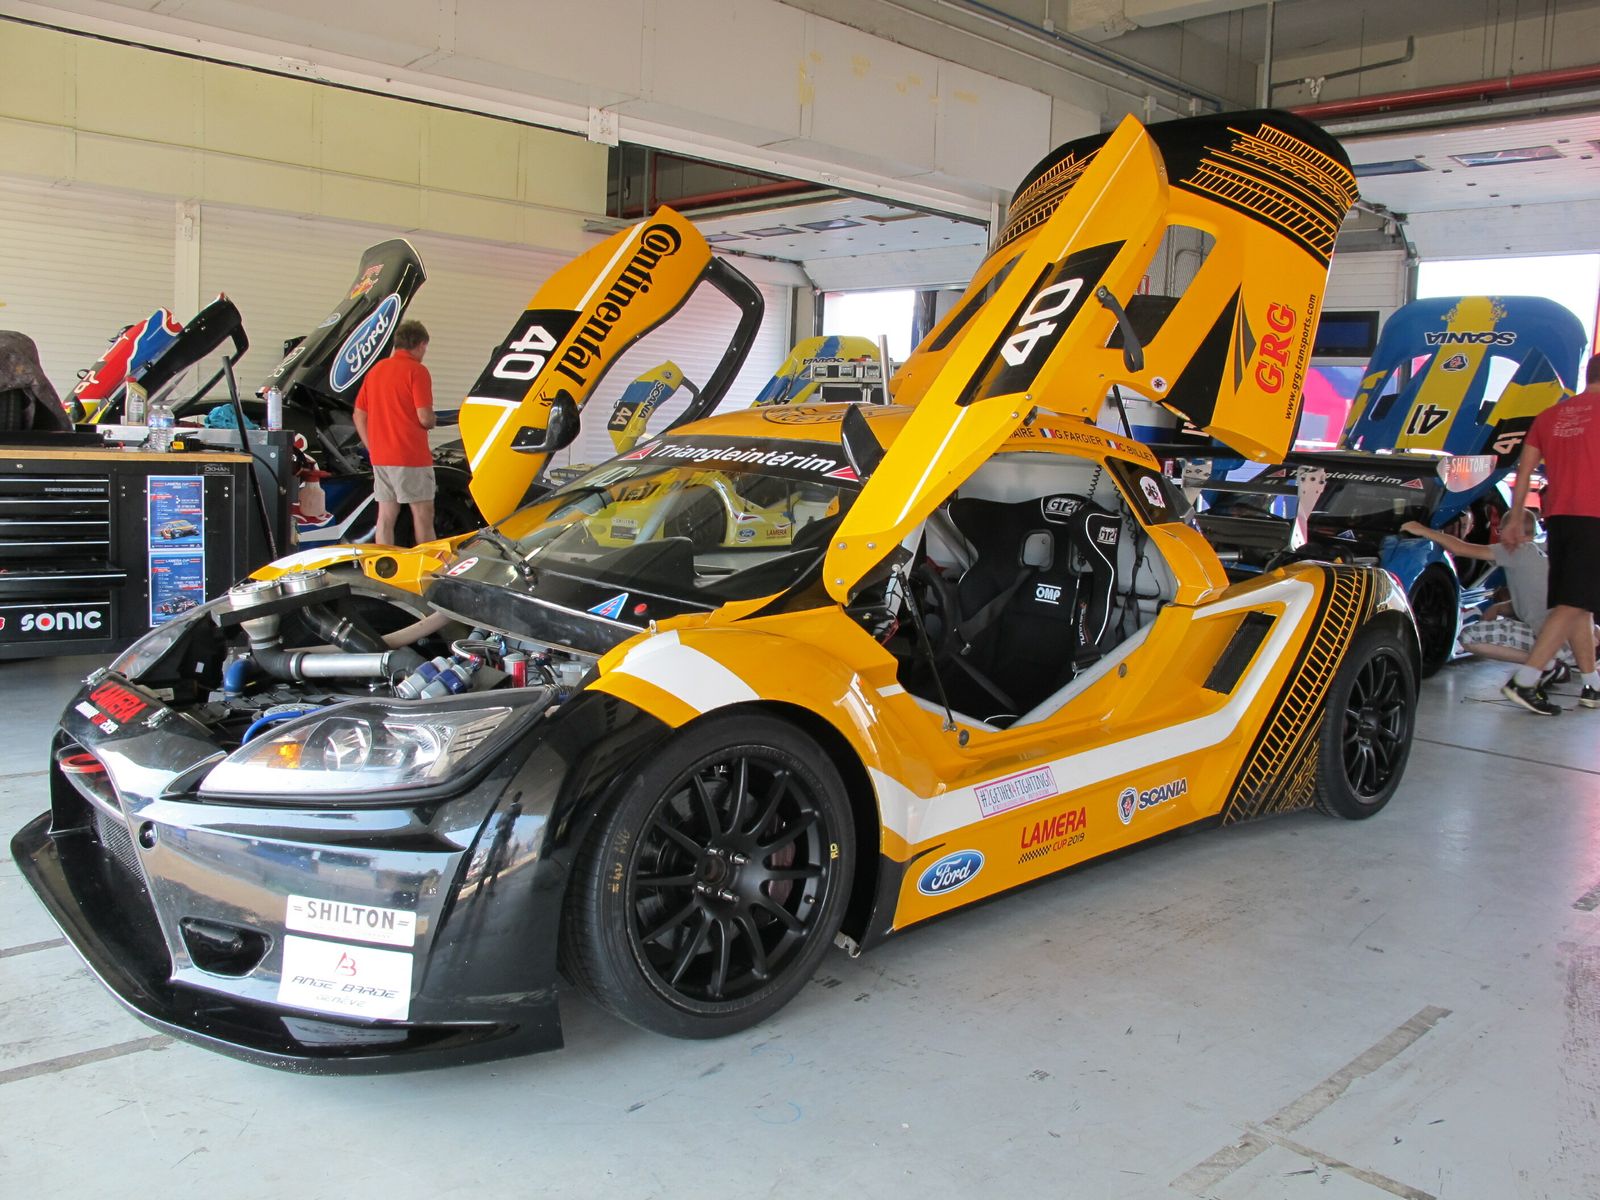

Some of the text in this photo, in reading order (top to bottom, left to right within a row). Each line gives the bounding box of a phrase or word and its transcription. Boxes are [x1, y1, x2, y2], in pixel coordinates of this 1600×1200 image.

[553, 223, 682, 387] Continental
[1000, 277, 1083, 367] 40
[345, 312, 389, 373] Ford
[492, 325, 558, 381] 40
[1255, 301, 1297, 394] GRG
[1424, 331, 1518, 346] SCANIA
[1285, 293, 1317, 421] www.grg-transports.com
[637, 381, 666, 419] SCANIA
[611, 406, 633, 426] 44
[1406, 403, 1450, 435] 41
[1054, 428, 1103, 446] G.FARGIER
[1118, 441, 1154, 462] C.BILLET
[1492, 430, 1527, 454] 41
[651, 443, 838, 473] Triangleintérim
[1451, 457, 1485, 472] SHILTON
[766, 528, 787, 536] LAMERA
[1035, 587, 1061, 600] OMP
[21, 611, 102, 632] SONIC
[90, 681, 148, 724] LAMERA
[1138, 776, 1188, 810] SCANIA
[1021, 806, 1087, 849] LAMERA
[1052, 832, 1085, 851] CUP 2019
[931, 856, 971, 890] Ford
[307, 900, 395, 930] SHILTON
[291, 975, 400, 999] ANGE BARDE
